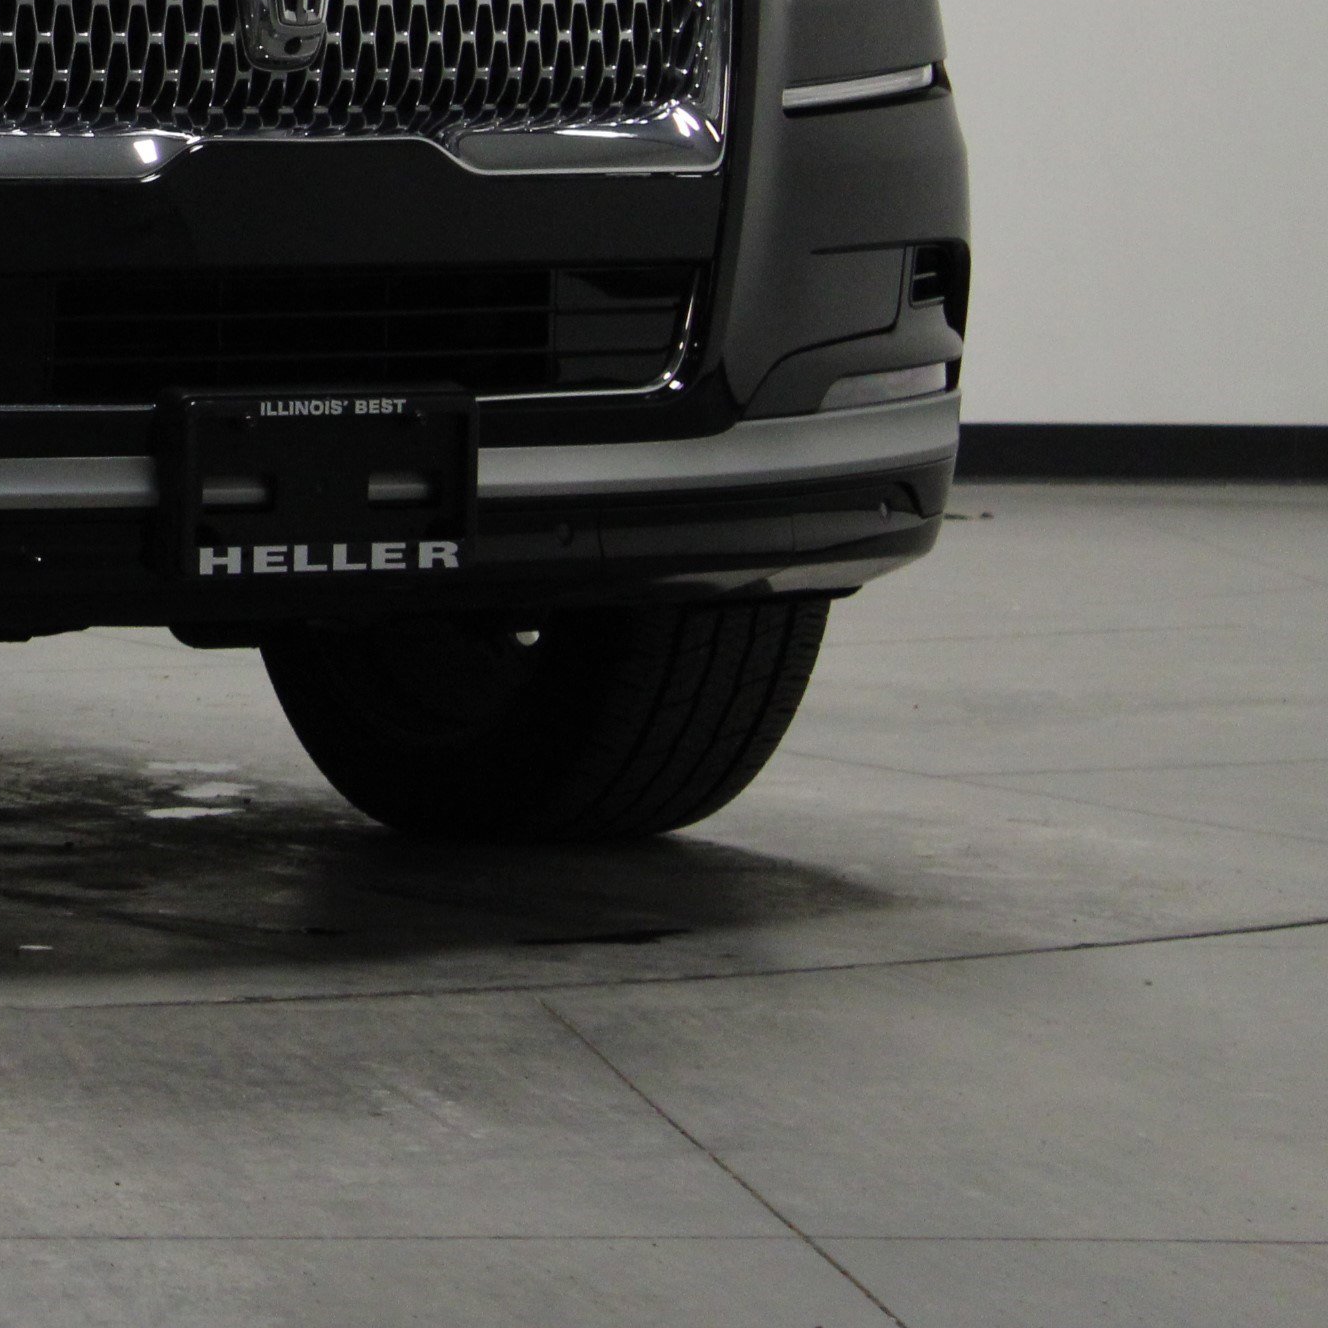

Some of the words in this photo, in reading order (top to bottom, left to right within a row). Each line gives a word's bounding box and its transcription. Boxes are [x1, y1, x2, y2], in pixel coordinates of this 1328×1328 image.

[259, 399, 350, 418] ILLINOIS'
[354, 397, 408, 415] BEST
[198, 539, 461, 576] HELLER
